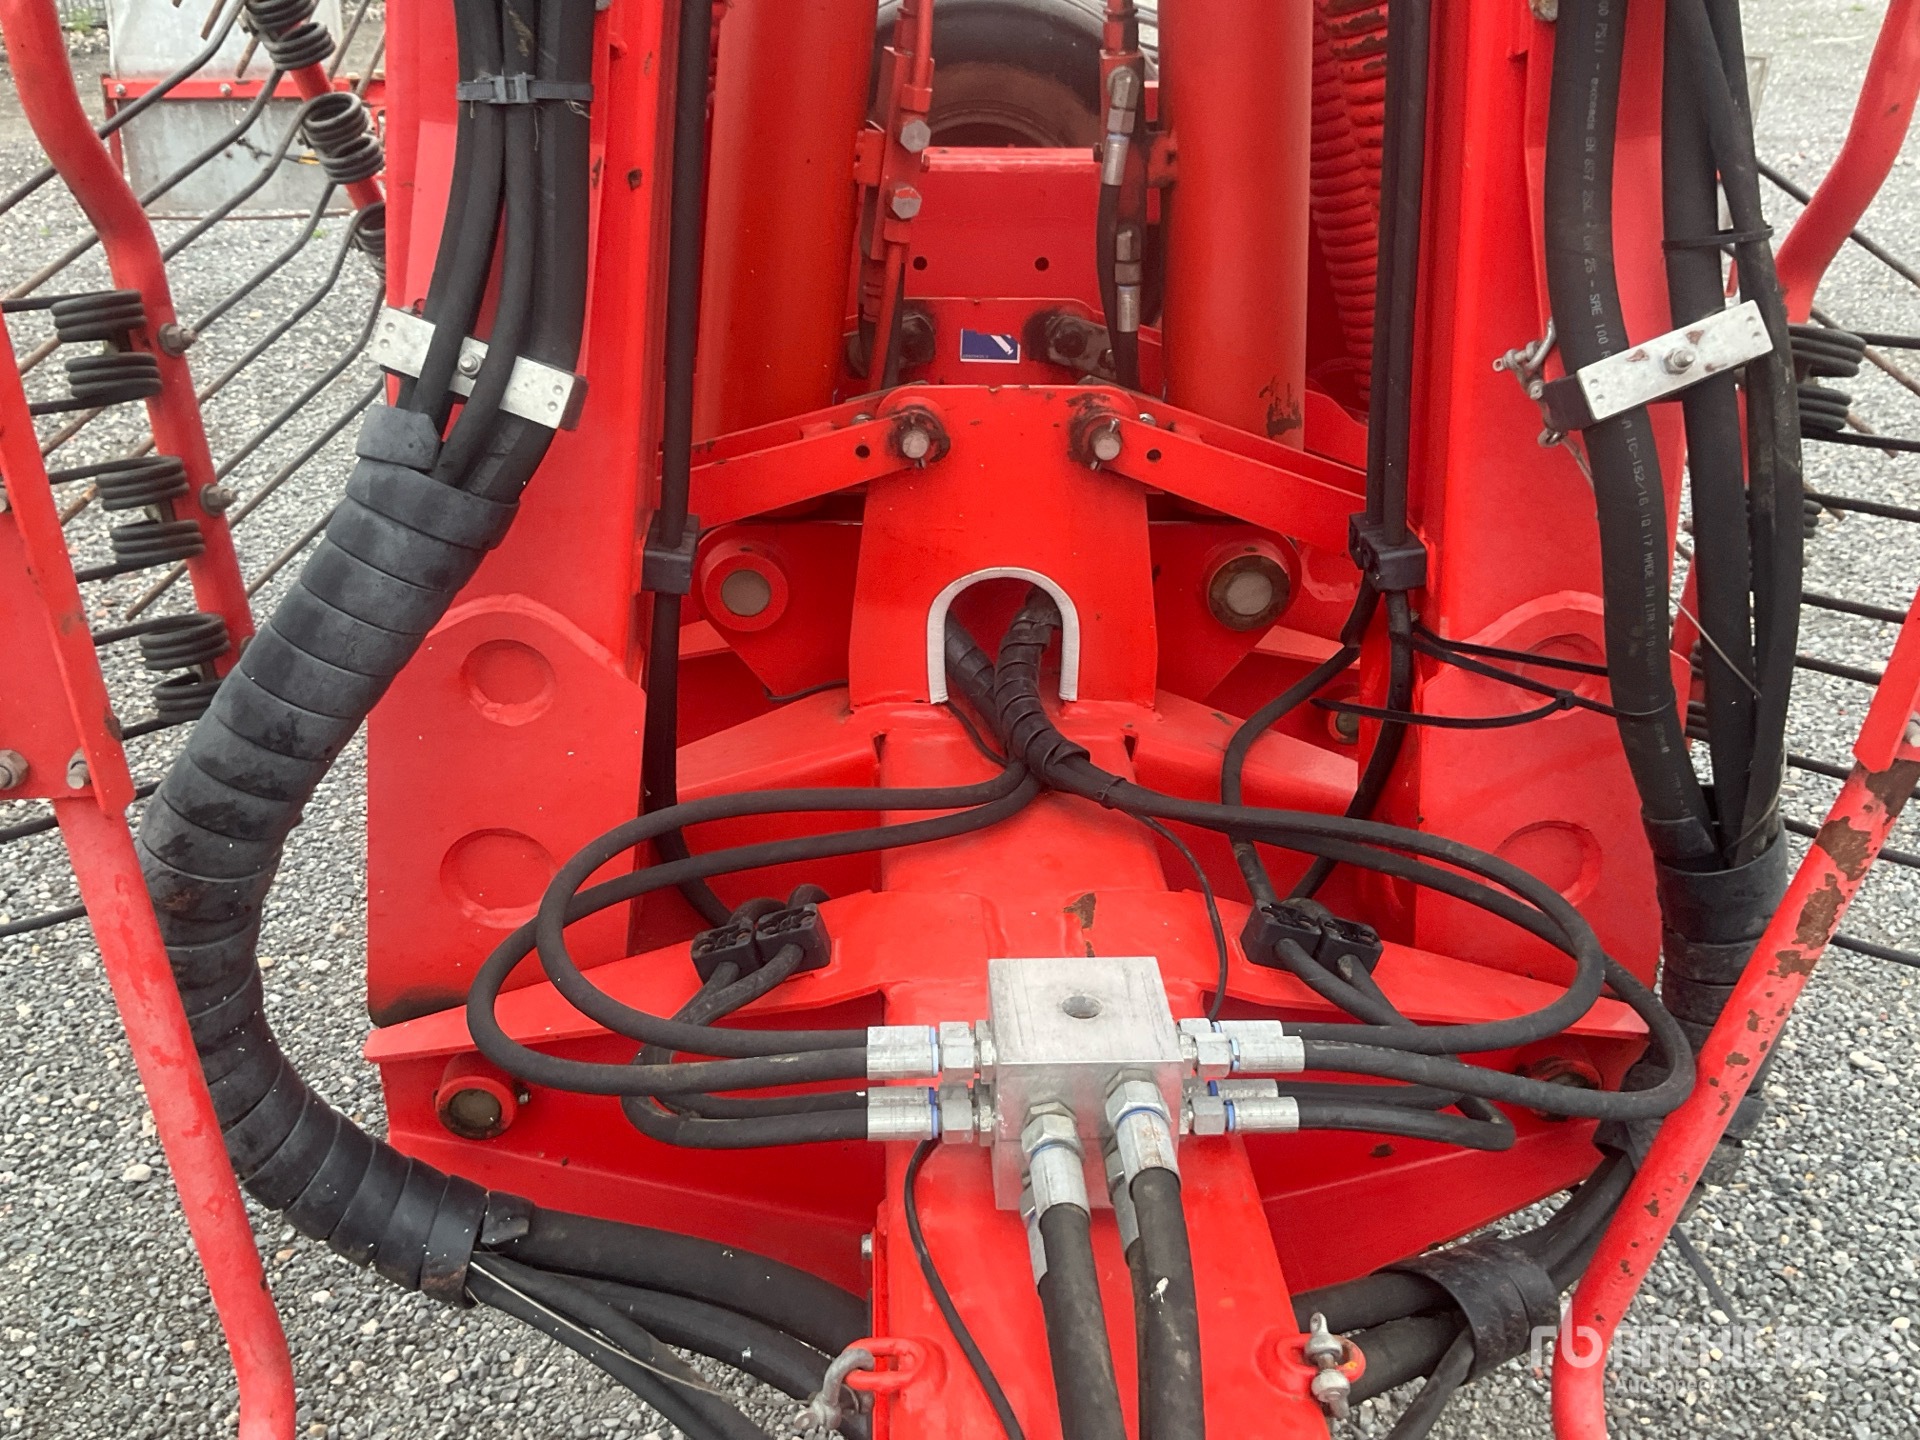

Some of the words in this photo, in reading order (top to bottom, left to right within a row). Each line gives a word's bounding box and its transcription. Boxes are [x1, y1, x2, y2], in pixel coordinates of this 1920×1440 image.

[1586, 77, 1601, 130] exceeds
[1585, 137, 1597, 153] EN
[1584, 257, 1597, 274] 25
[1589, 293, 1604, 316] SAE
[1594, 323, 1610, 345] 100
[1644, 551, 1656, 579] MADE
[1645, 585, 1656, 597] IN
[1645, 603, 1657, 631] ITALY
